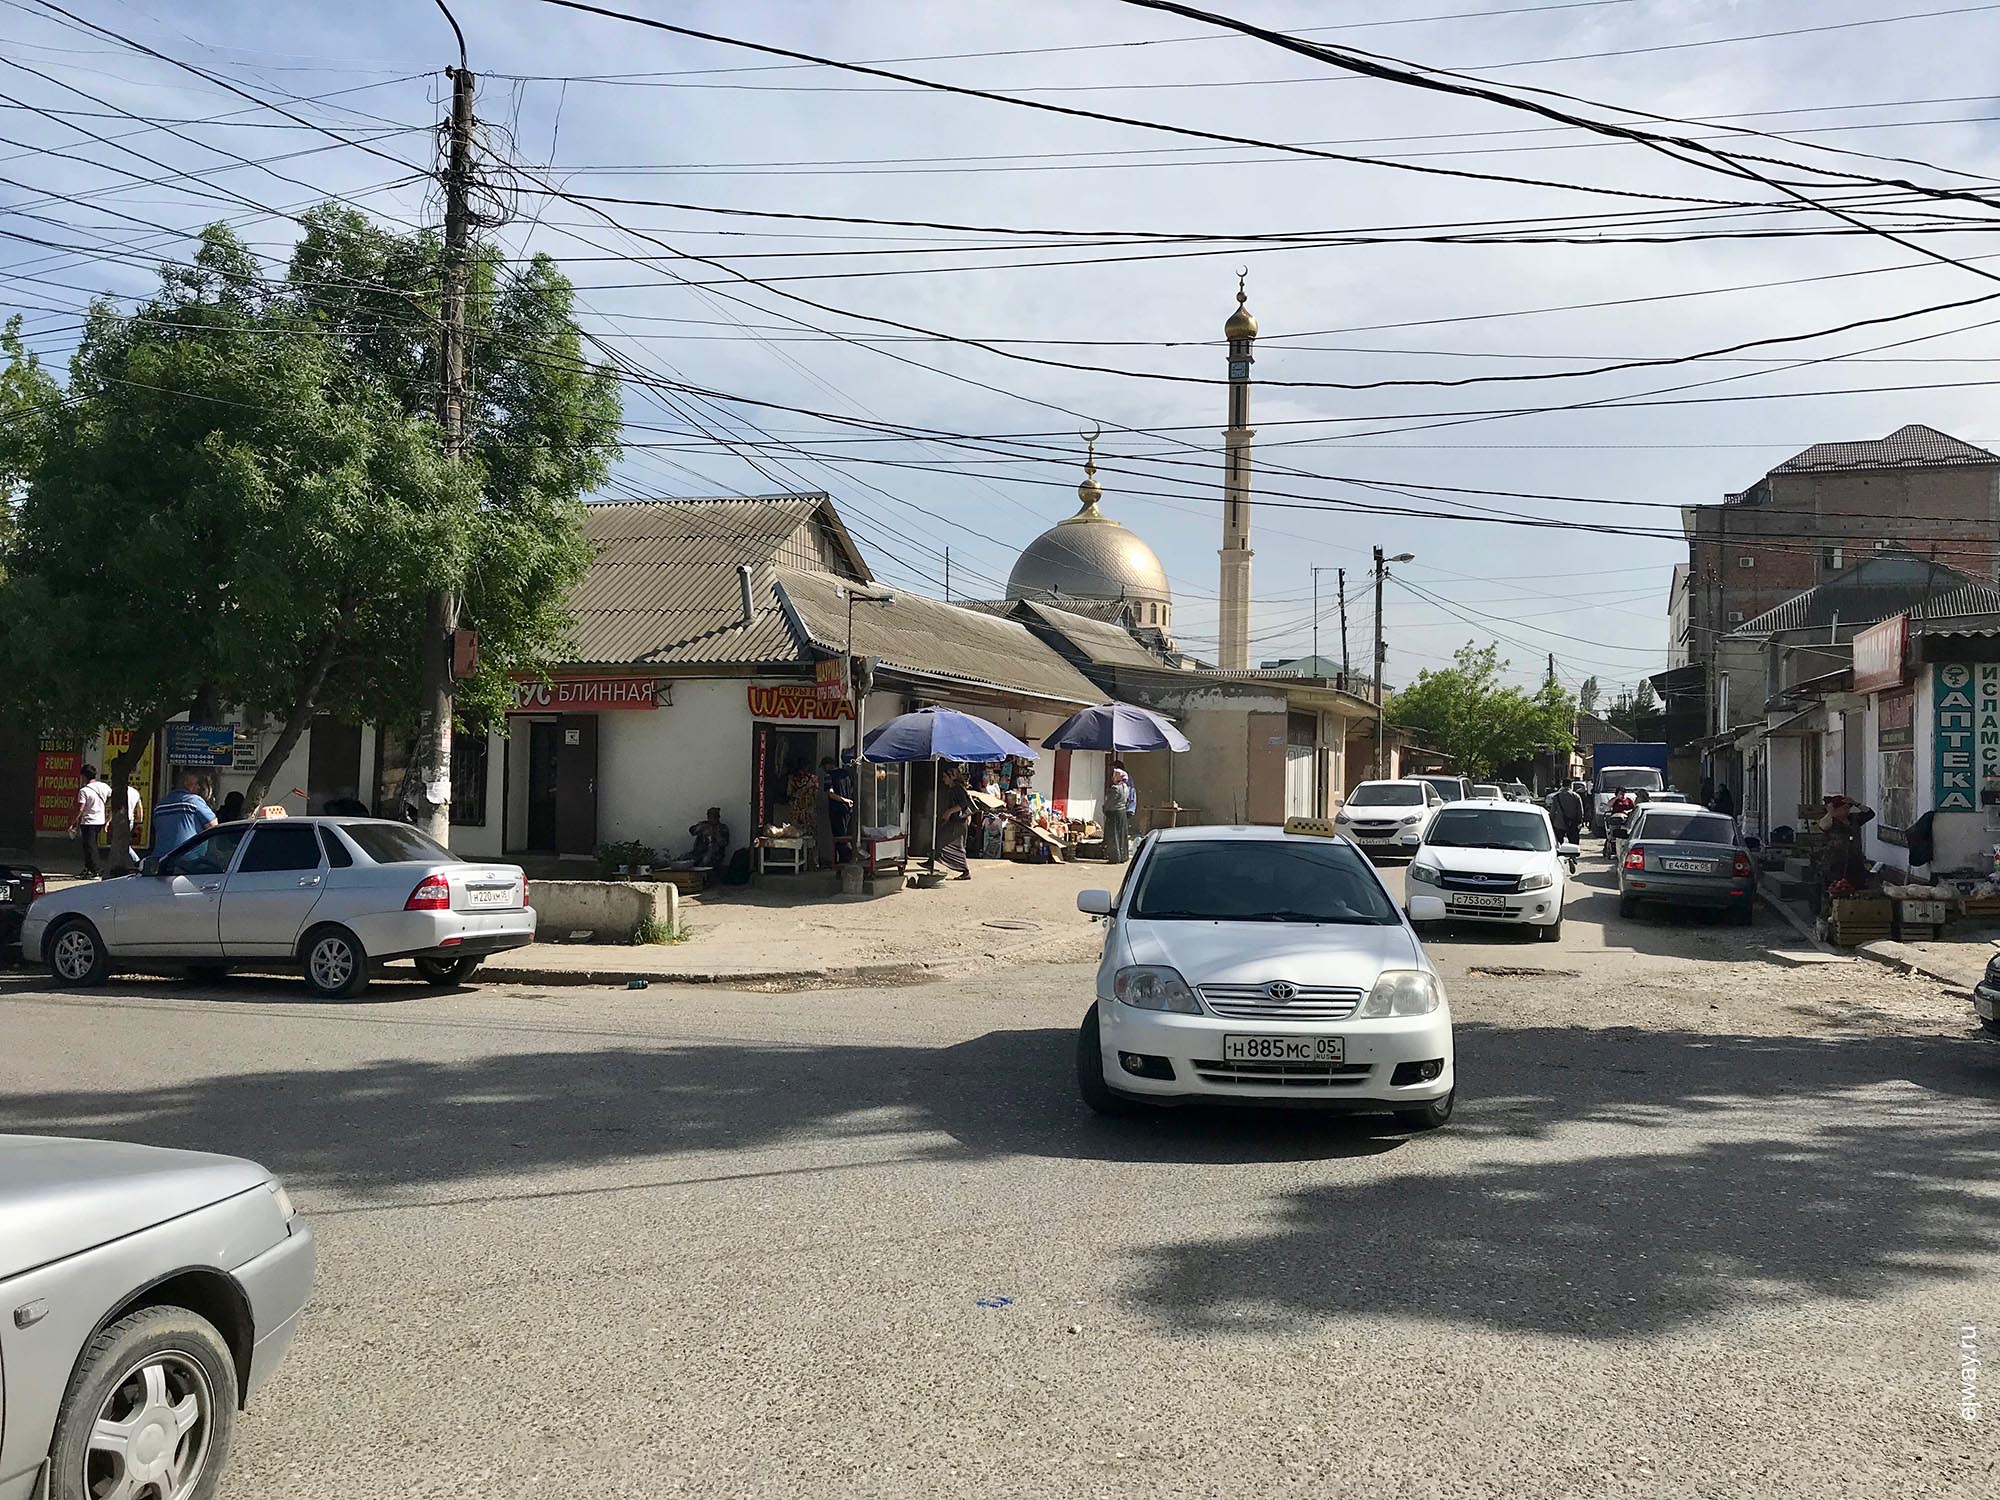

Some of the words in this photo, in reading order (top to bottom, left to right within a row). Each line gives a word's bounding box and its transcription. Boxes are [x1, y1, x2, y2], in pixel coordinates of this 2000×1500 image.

[559, 683, 652, 702] БЛИННАЯ
[749, 687, 854, 719] ШАУРМА
[1980, 667, 1999, 777] ИСЛАМСК
[1939, 690, 1972, 808] АПТЕКА
[45, 757, 74, 769] РЕМОНТ
[38, 776, 43, 788] И
[44, 776, 79, 790] ПРОДАЖА
[40, 794, 75, 808] ШВЕЙНЫХ
[43, 815, 69, 826] МАШИН
[1233, 1039, 1311, 1058] Н885МС
[1317, 1039, 1336, 1053] 05
